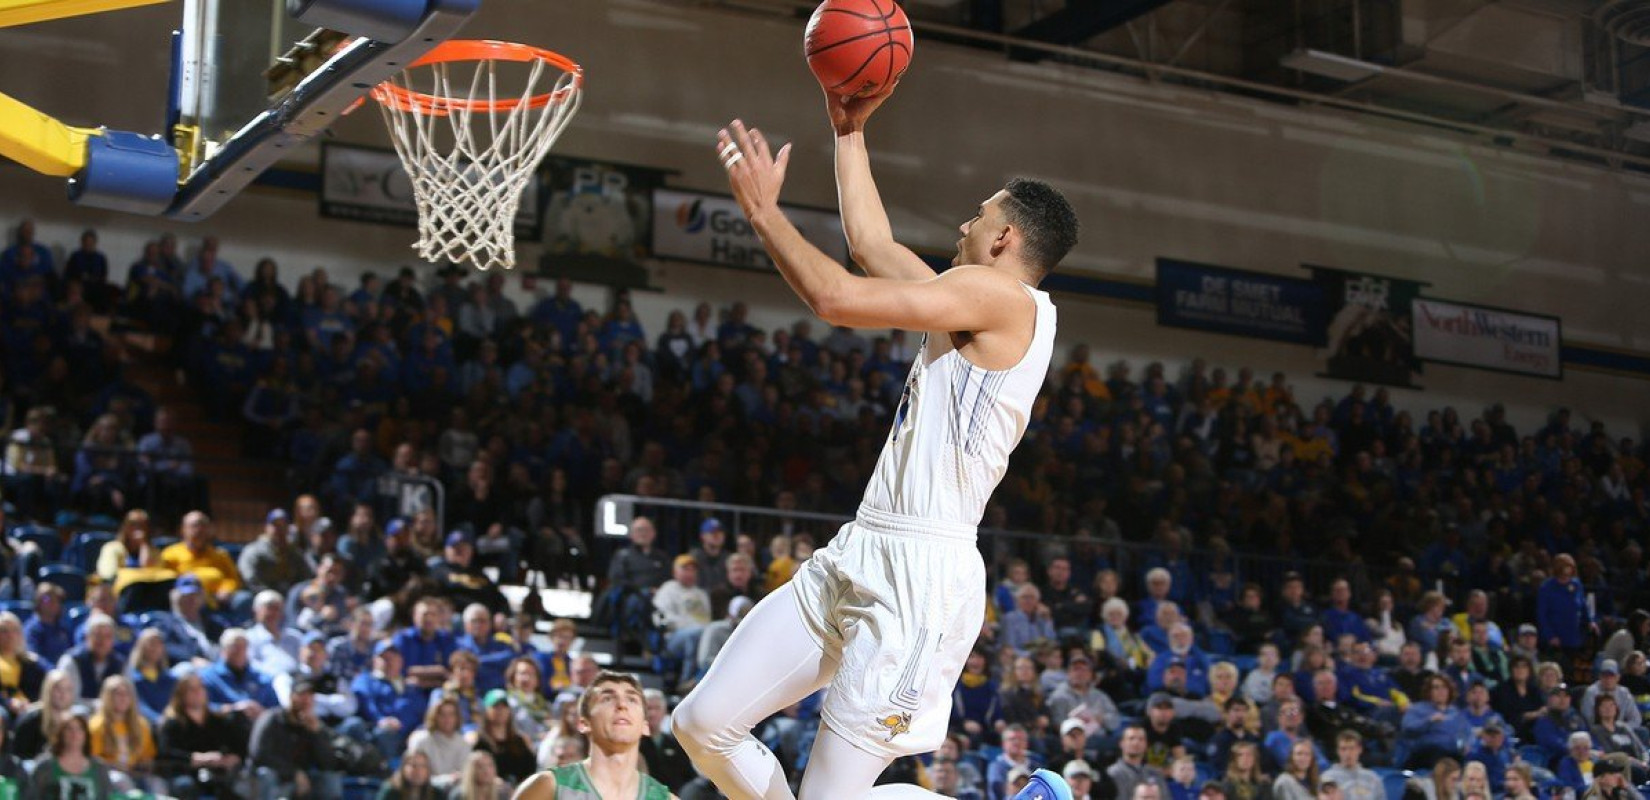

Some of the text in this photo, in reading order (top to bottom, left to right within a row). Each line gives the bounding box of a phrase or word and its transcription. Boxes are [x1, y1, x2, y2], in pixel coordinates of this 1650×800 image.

[1201, 275, 1228, 296] DE
[1175, 289, 1228, 313] FARM
[1231, 299, 1304, 323] MUTUAL
[1420, 302, 1550, 346] NorthWestern
[402, 484, 428, 515] K
[604, 501, 628, 535] L
